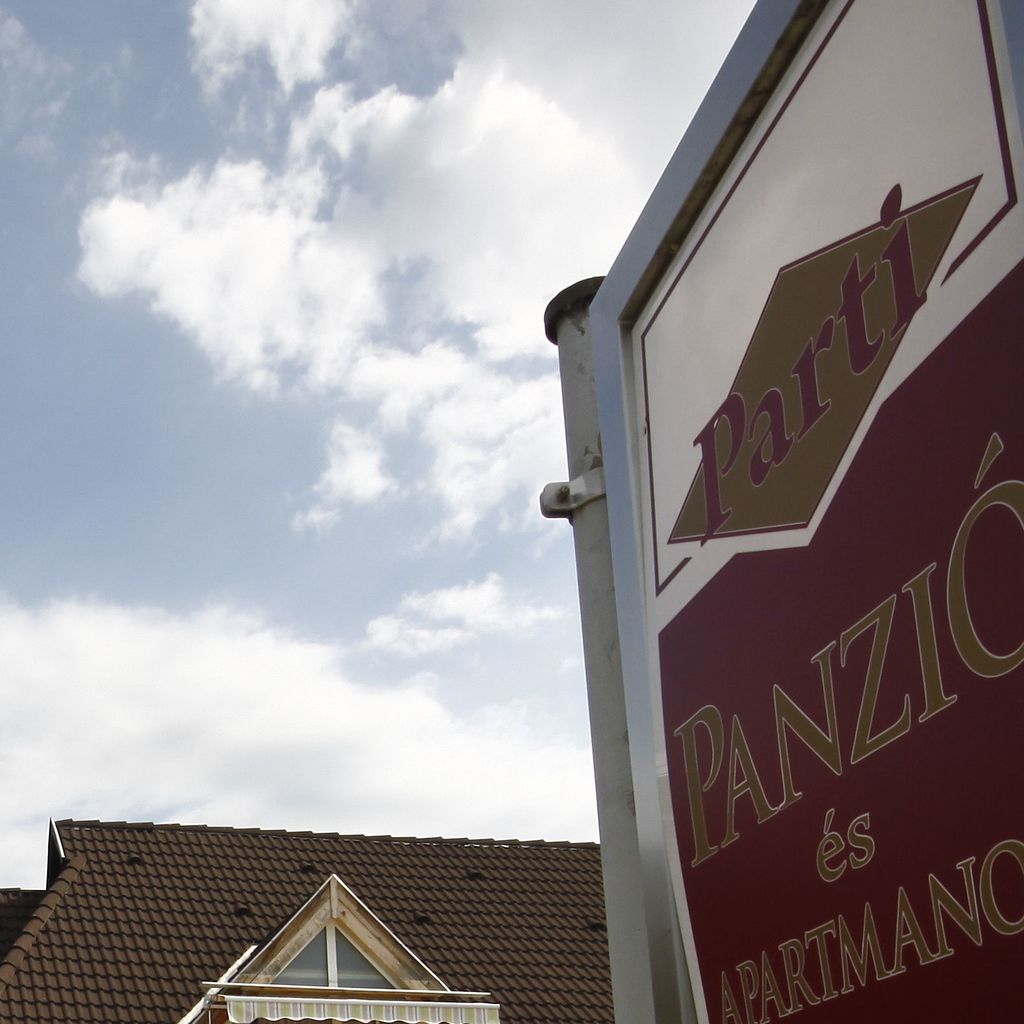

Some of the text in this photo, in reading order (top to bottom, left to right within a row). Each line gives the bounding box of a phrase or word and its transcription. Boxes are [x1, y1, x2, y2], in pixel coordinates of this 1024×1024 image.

[693, 183, 927, 546] Parti
[674, 432, 1024, 868] PANZIÓ
[817, 808, 876, 883] és
